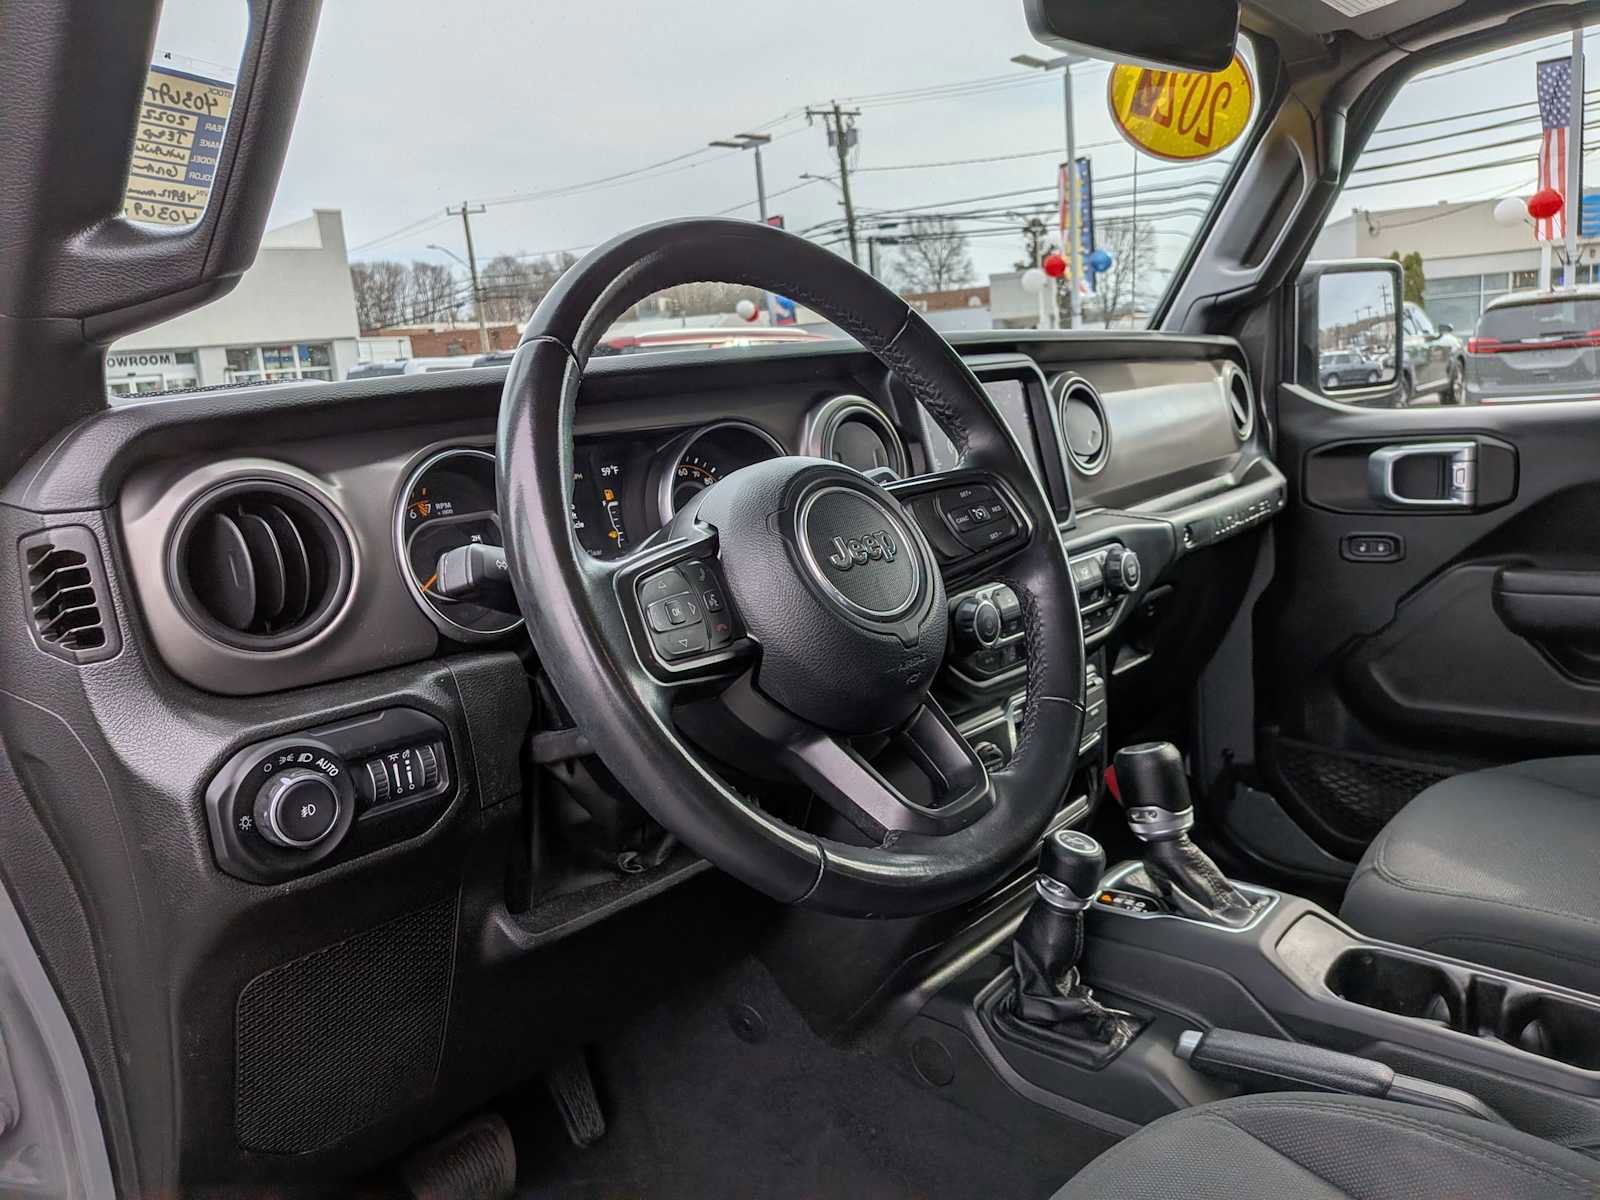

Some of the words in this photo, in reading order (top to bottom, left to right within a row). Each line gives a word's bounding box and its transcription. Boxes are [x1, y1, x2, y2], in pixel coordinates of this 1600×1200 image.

[409, 508, 417, 519] 6
[435, 502, 452, 510] RPM
[830, 529, 898, 571] Jeep
[315, 757, 340, 777] AUTO
